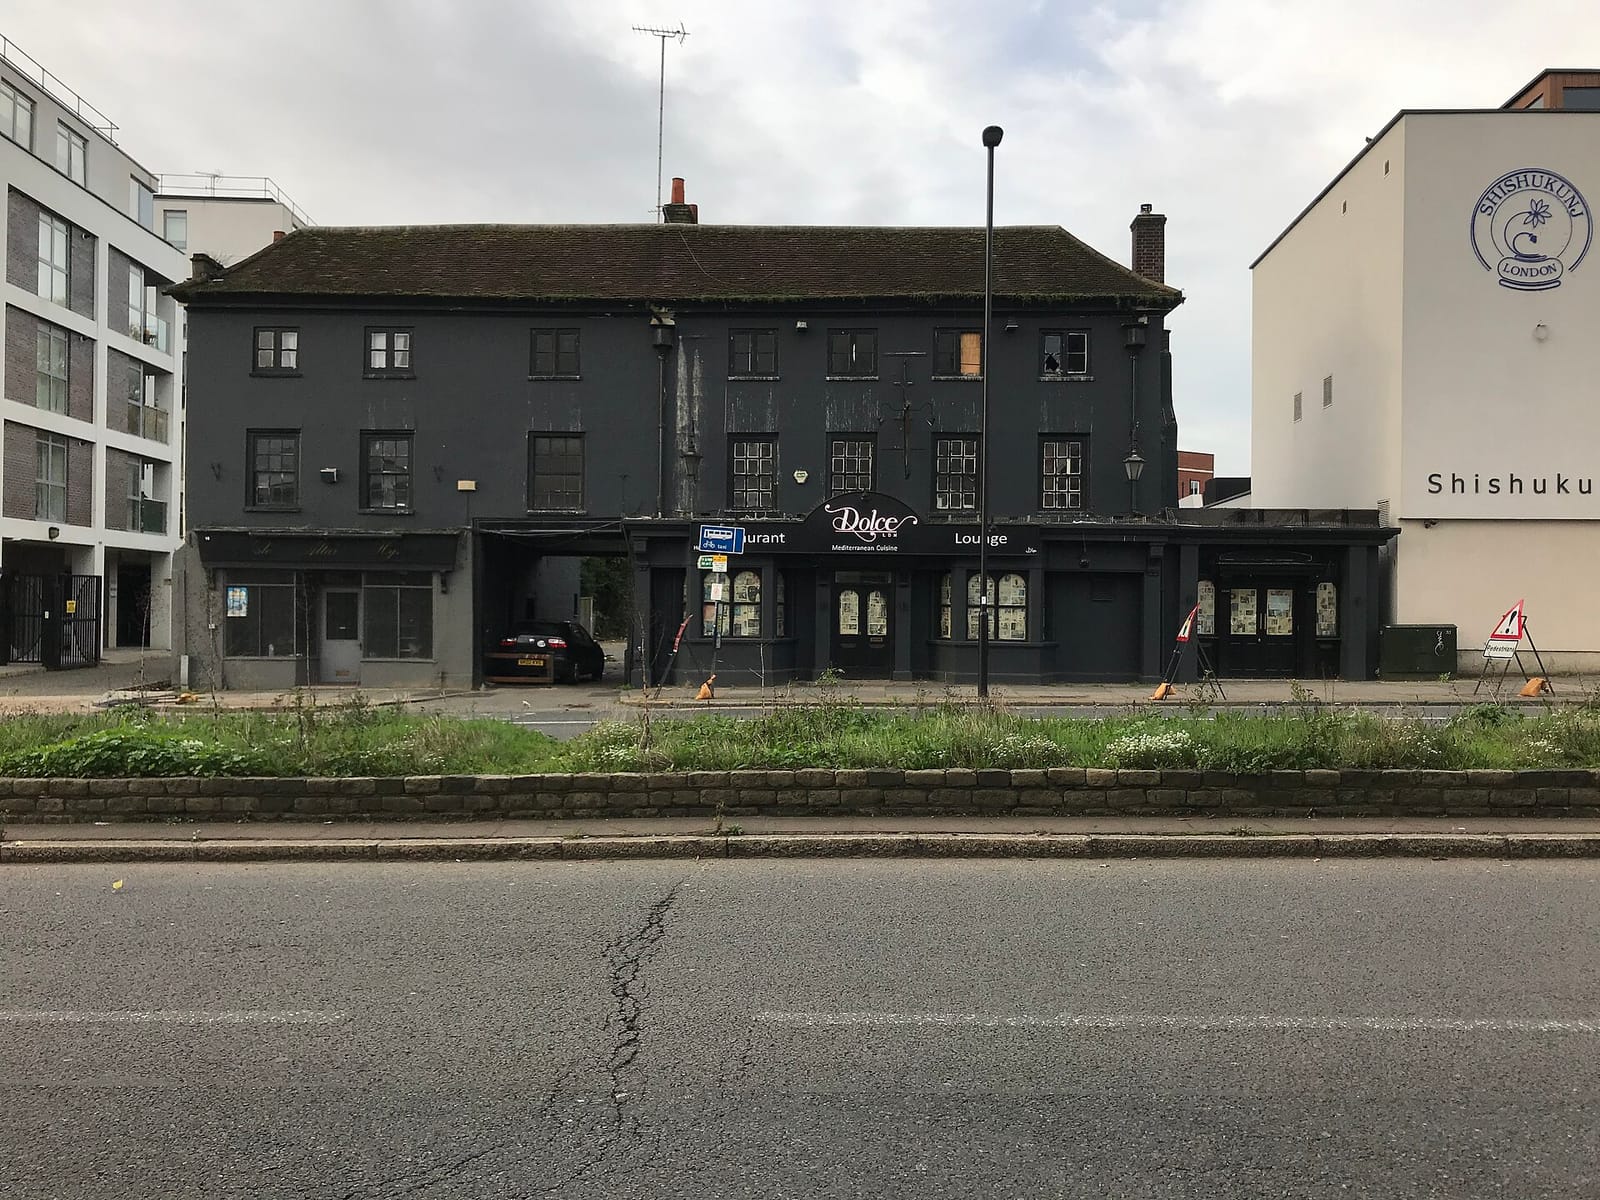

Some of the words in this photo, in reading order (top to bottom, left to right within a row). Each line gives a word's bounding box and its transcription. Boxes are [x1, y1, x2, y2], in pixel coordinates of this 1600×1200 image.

[1480, 174, 1584, 218] SHISHUKUNJ
[1502, 263, 1557, 278] LONDON
[1428, 473, 1593, 494] Shishuku
[825, 504, 918, 542] Dolce
